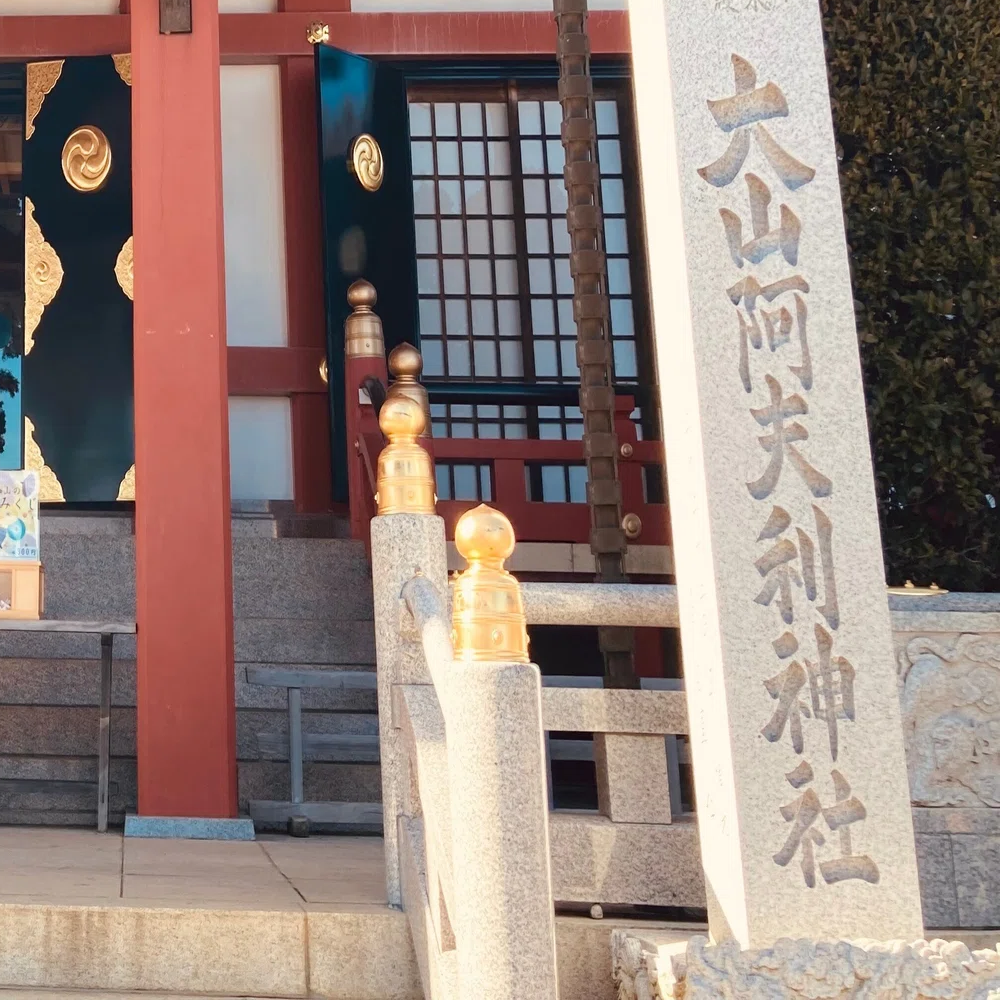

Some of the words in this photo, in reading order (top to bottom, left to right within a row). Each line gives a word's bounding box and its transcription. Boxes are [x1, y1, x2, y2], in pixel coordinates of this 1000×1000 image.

[697, 53, 879, 888] 大山阿夫利神社
